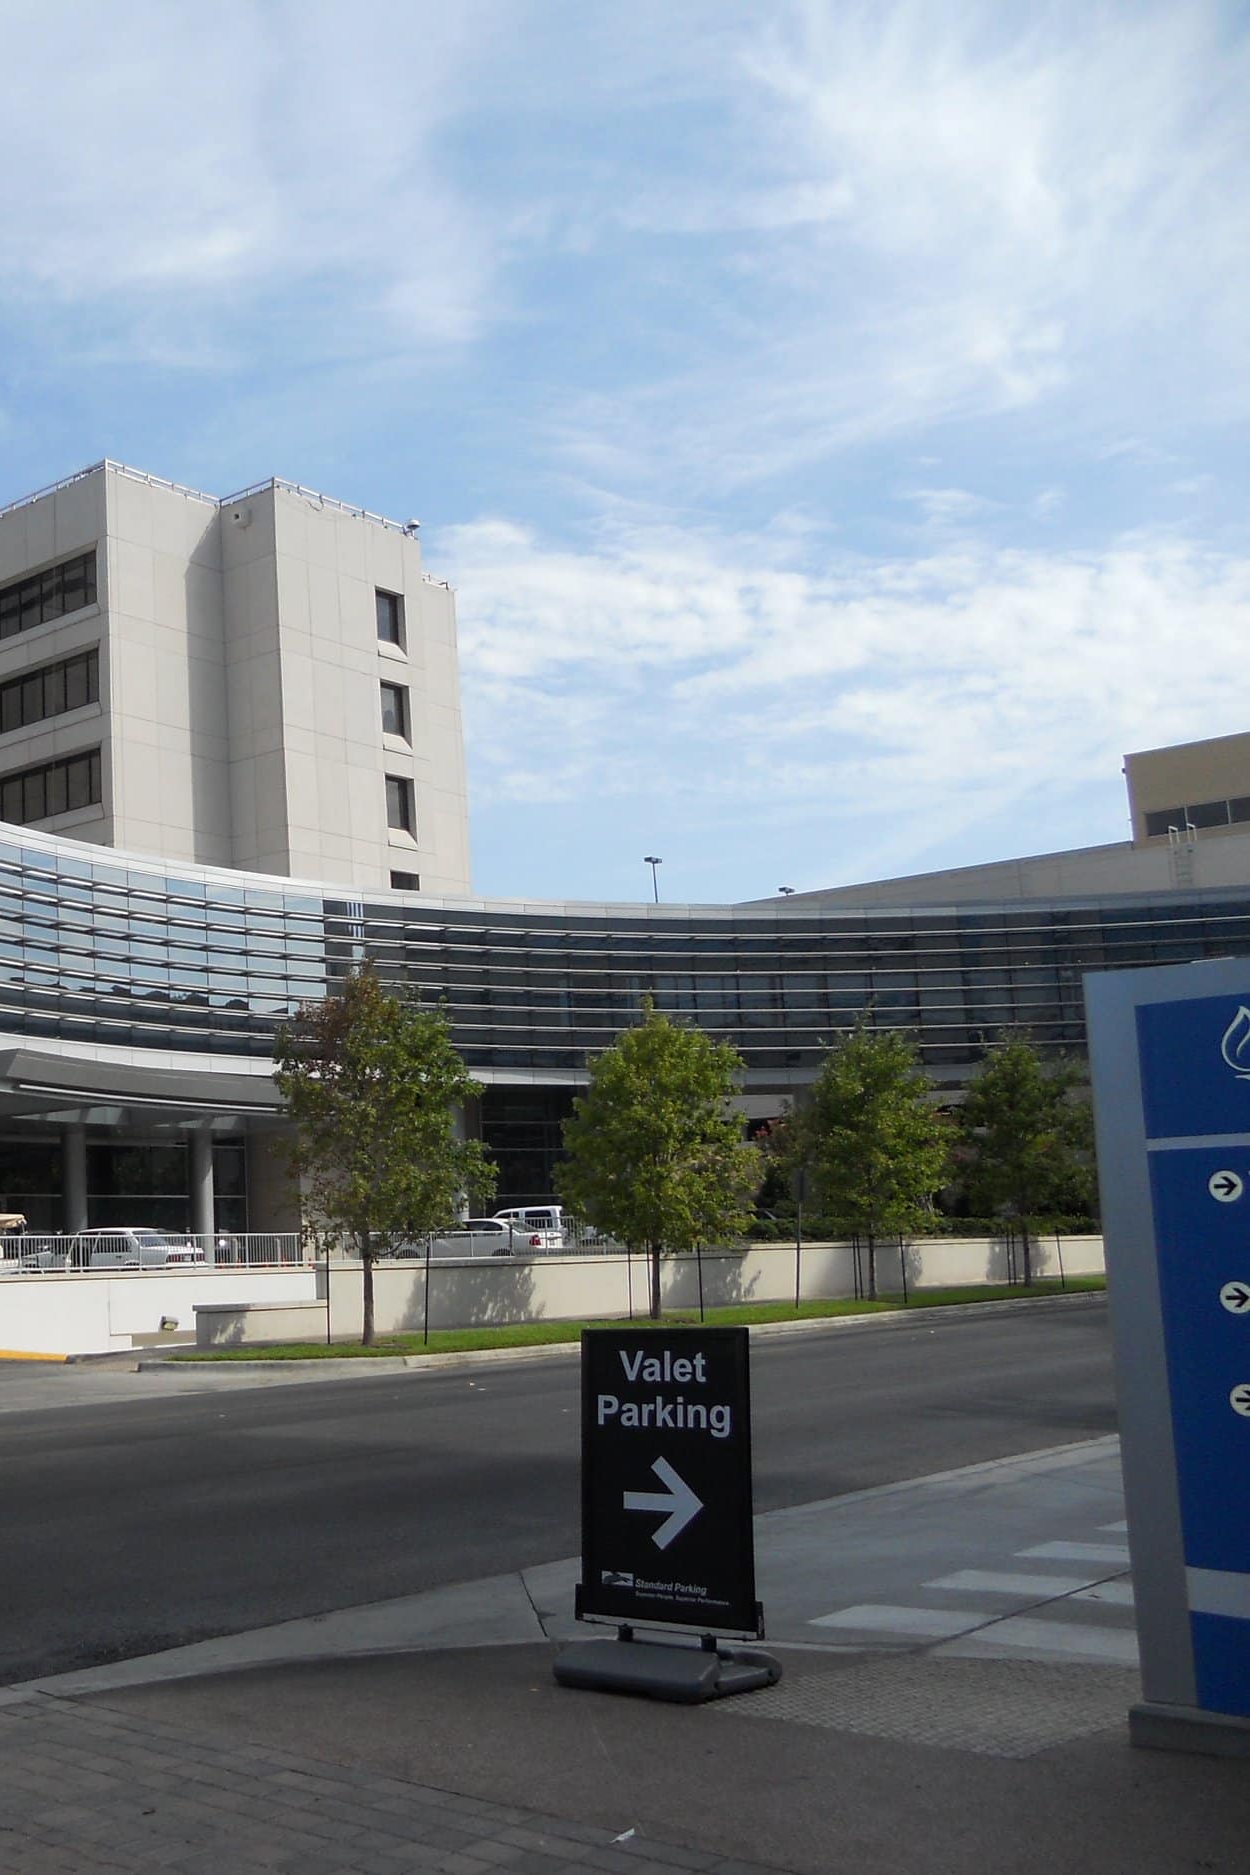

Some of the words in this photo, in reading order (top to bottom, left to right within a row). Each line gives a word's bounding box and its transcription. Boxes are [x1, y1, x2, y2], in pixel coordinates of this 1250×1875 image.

[619, 1350, 707, 1382] Valet
[597, 1394, 731, 1438] Parking
[635, 1579, 673, 1591] Standard
[674, 1583, 708, 1596] Parking
